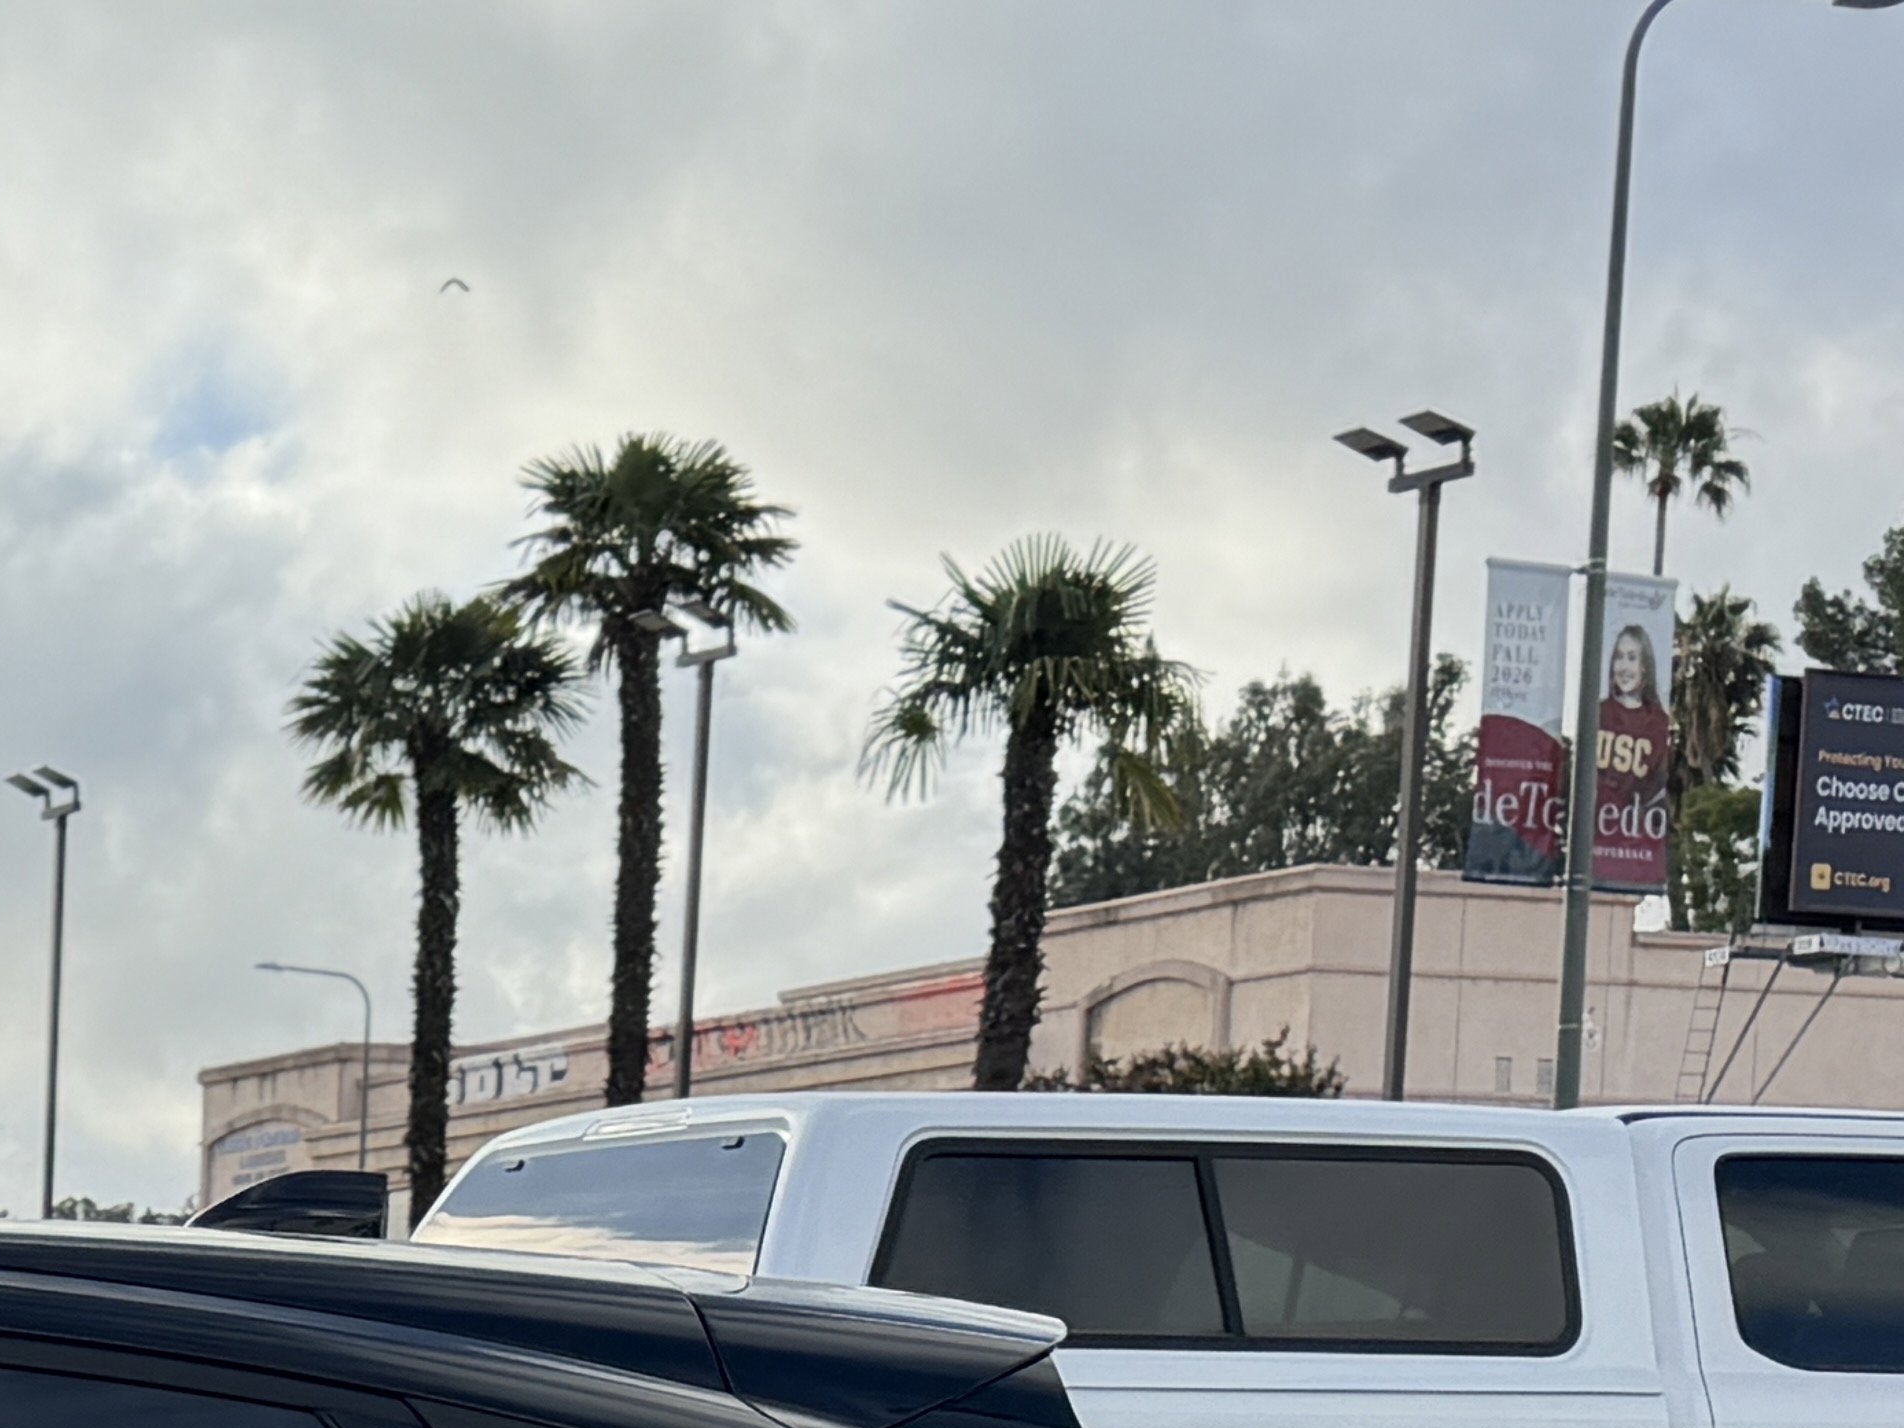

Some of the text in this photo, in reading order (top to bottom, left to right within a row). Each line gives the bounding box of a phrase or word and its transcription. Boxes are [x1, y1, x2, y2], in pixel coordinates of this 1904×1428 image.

[1496, 603, 1544, 621] APPLY
[1493, 621, 1547, 641] TODAY
[1493, 643, 1539, 666] FALL
[1841, 702, 1884, 723] CTEC
[1595, 729, 1652, 778] USC
[1816, 775, 1891, 801] Choose
